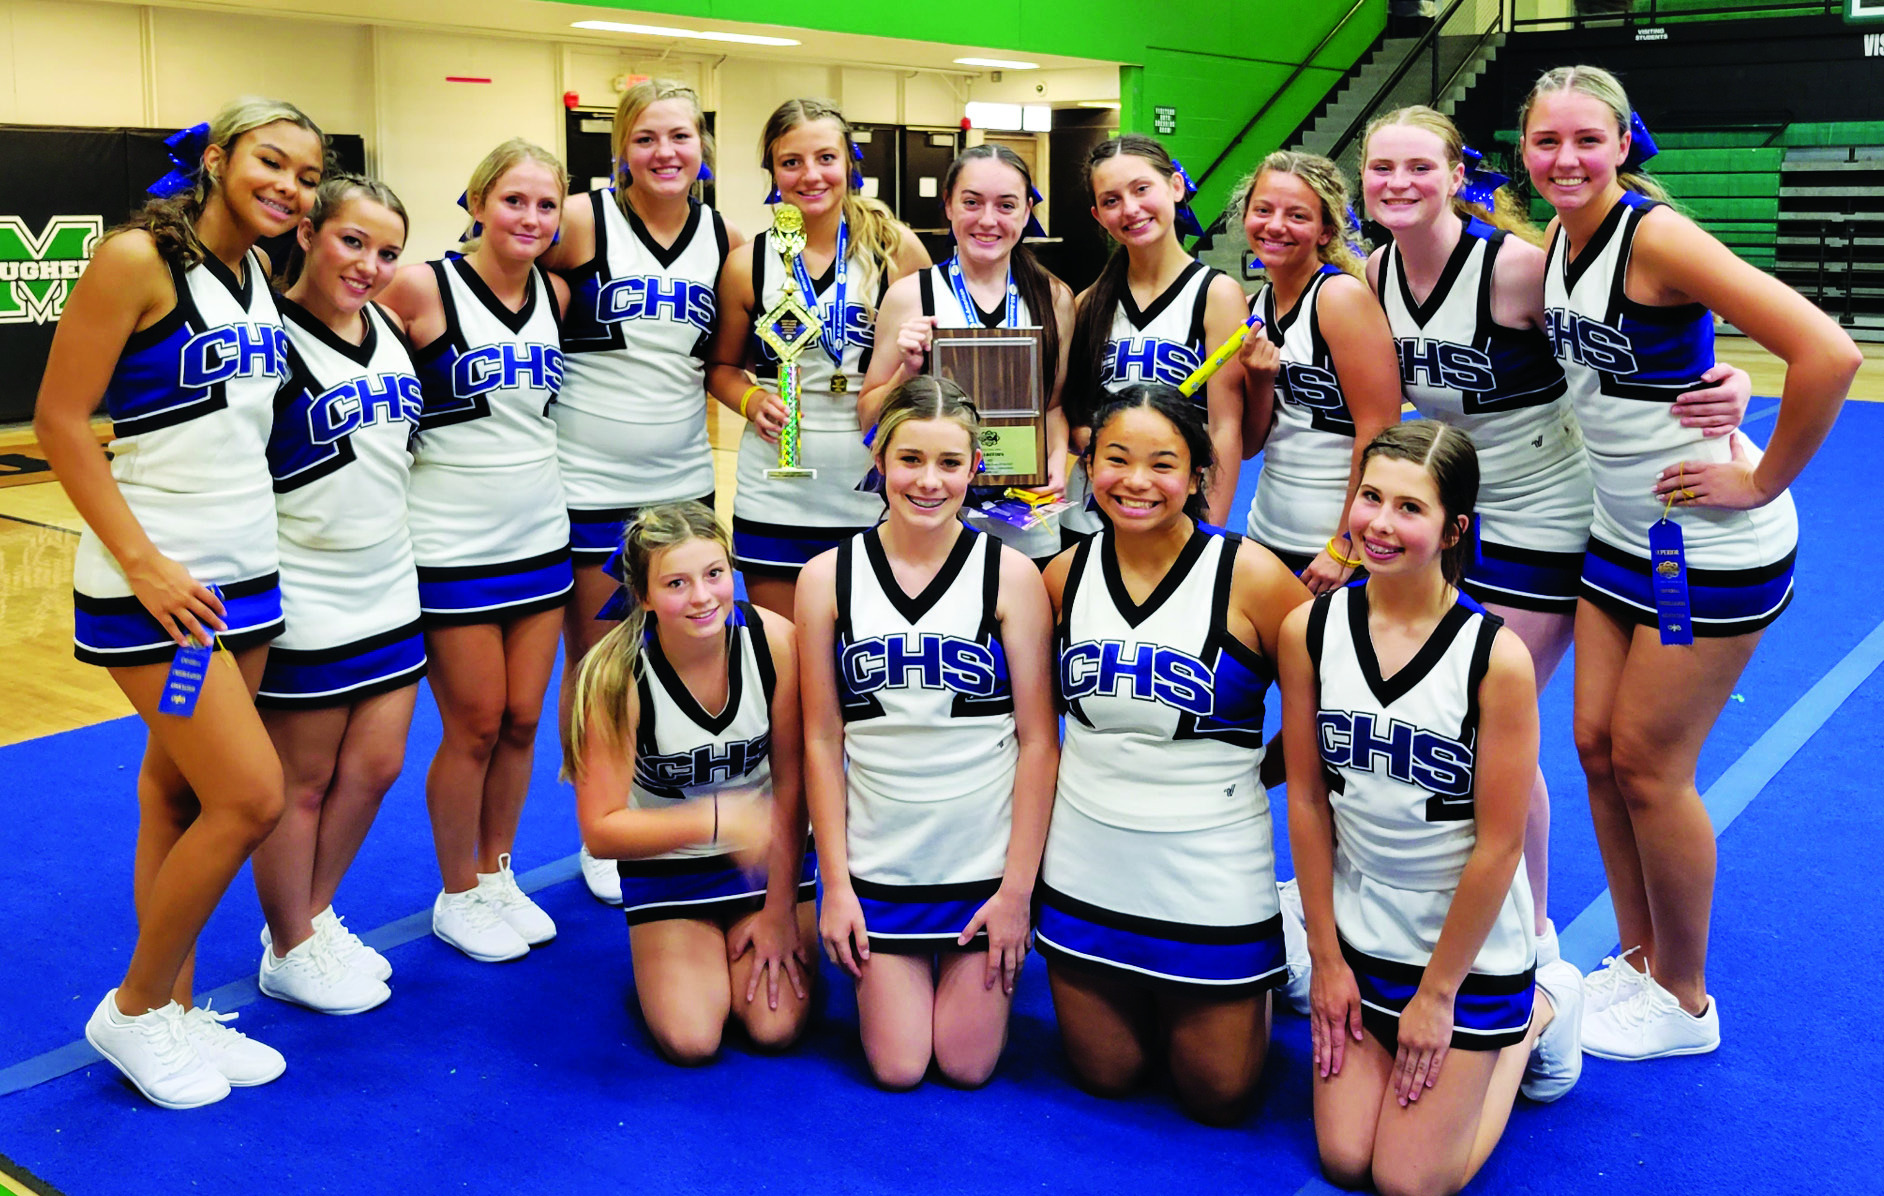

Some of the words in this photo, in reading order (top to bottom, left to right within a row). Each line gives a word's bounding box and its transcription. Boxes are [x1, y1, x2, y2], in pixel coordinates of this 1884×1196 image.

[1635, 33, 1669, 41] STUDENTS
[1638, 27, 1665, 35] VISITING
[596, 275, 717, 334] CHS
[452, 342, 564, 399] CHS
[1394, 337, 1497, 392] HS
[307, 372, 424, 445] CHS
[841, 633, 995, 697] CHS
[1060, 639, 1215, 716] CHS
[1316, 710, 1473, 796] CHS
